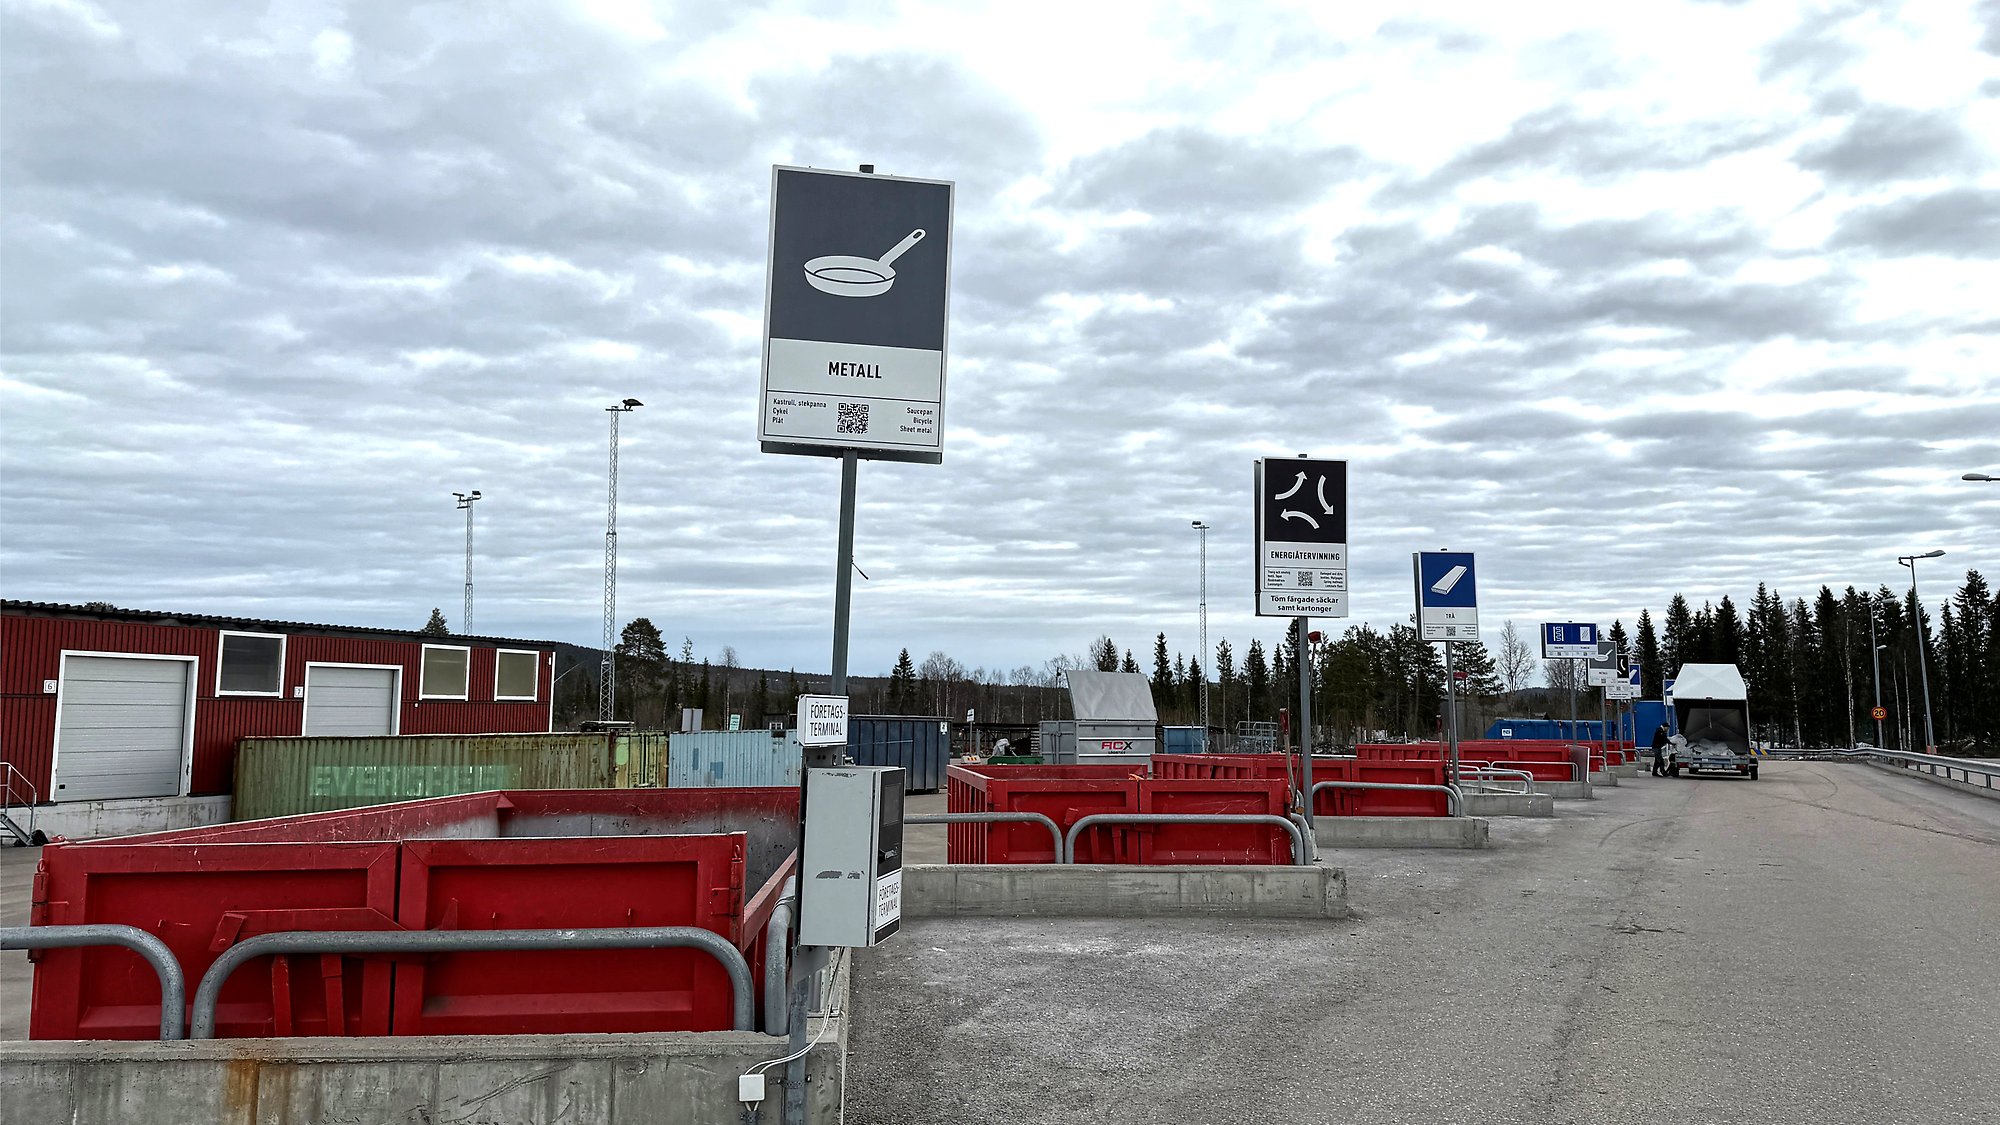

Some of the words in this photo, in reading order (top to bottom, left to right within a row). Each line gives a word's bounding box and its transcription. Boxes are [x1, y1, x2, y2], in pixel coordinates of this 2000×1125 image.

[828, 361, 882, 379] METALL
[773, 398, 797, 407] Kastrull,
[798, 400, 827, 408] stekpanna
[772, 407, 789, 415] Cykel
[906, 407, 933, 416] Saucepan
[772, 416, 784, 424] Plåt
[913, 416, 932, 425] Bicycle
[899, 425, 916, 433] Sheet
[1270, 550, 1340, 561] ENERGIÅTERVINNING
[1271, 595, 1286, 603] Töm
[1287, 595, 1315, 604] färgade
[1296, 605, 1332, 614] kartonger
[810, 701, 846, 719] FÖRETAGS-
[1874, 709, 1885, 717] 20
[809, 722, 843, 737] TERMINAL
[879, 881, 900, 902] FÖRETAGS-
[878, 897, 898, 917] TERMINAL
